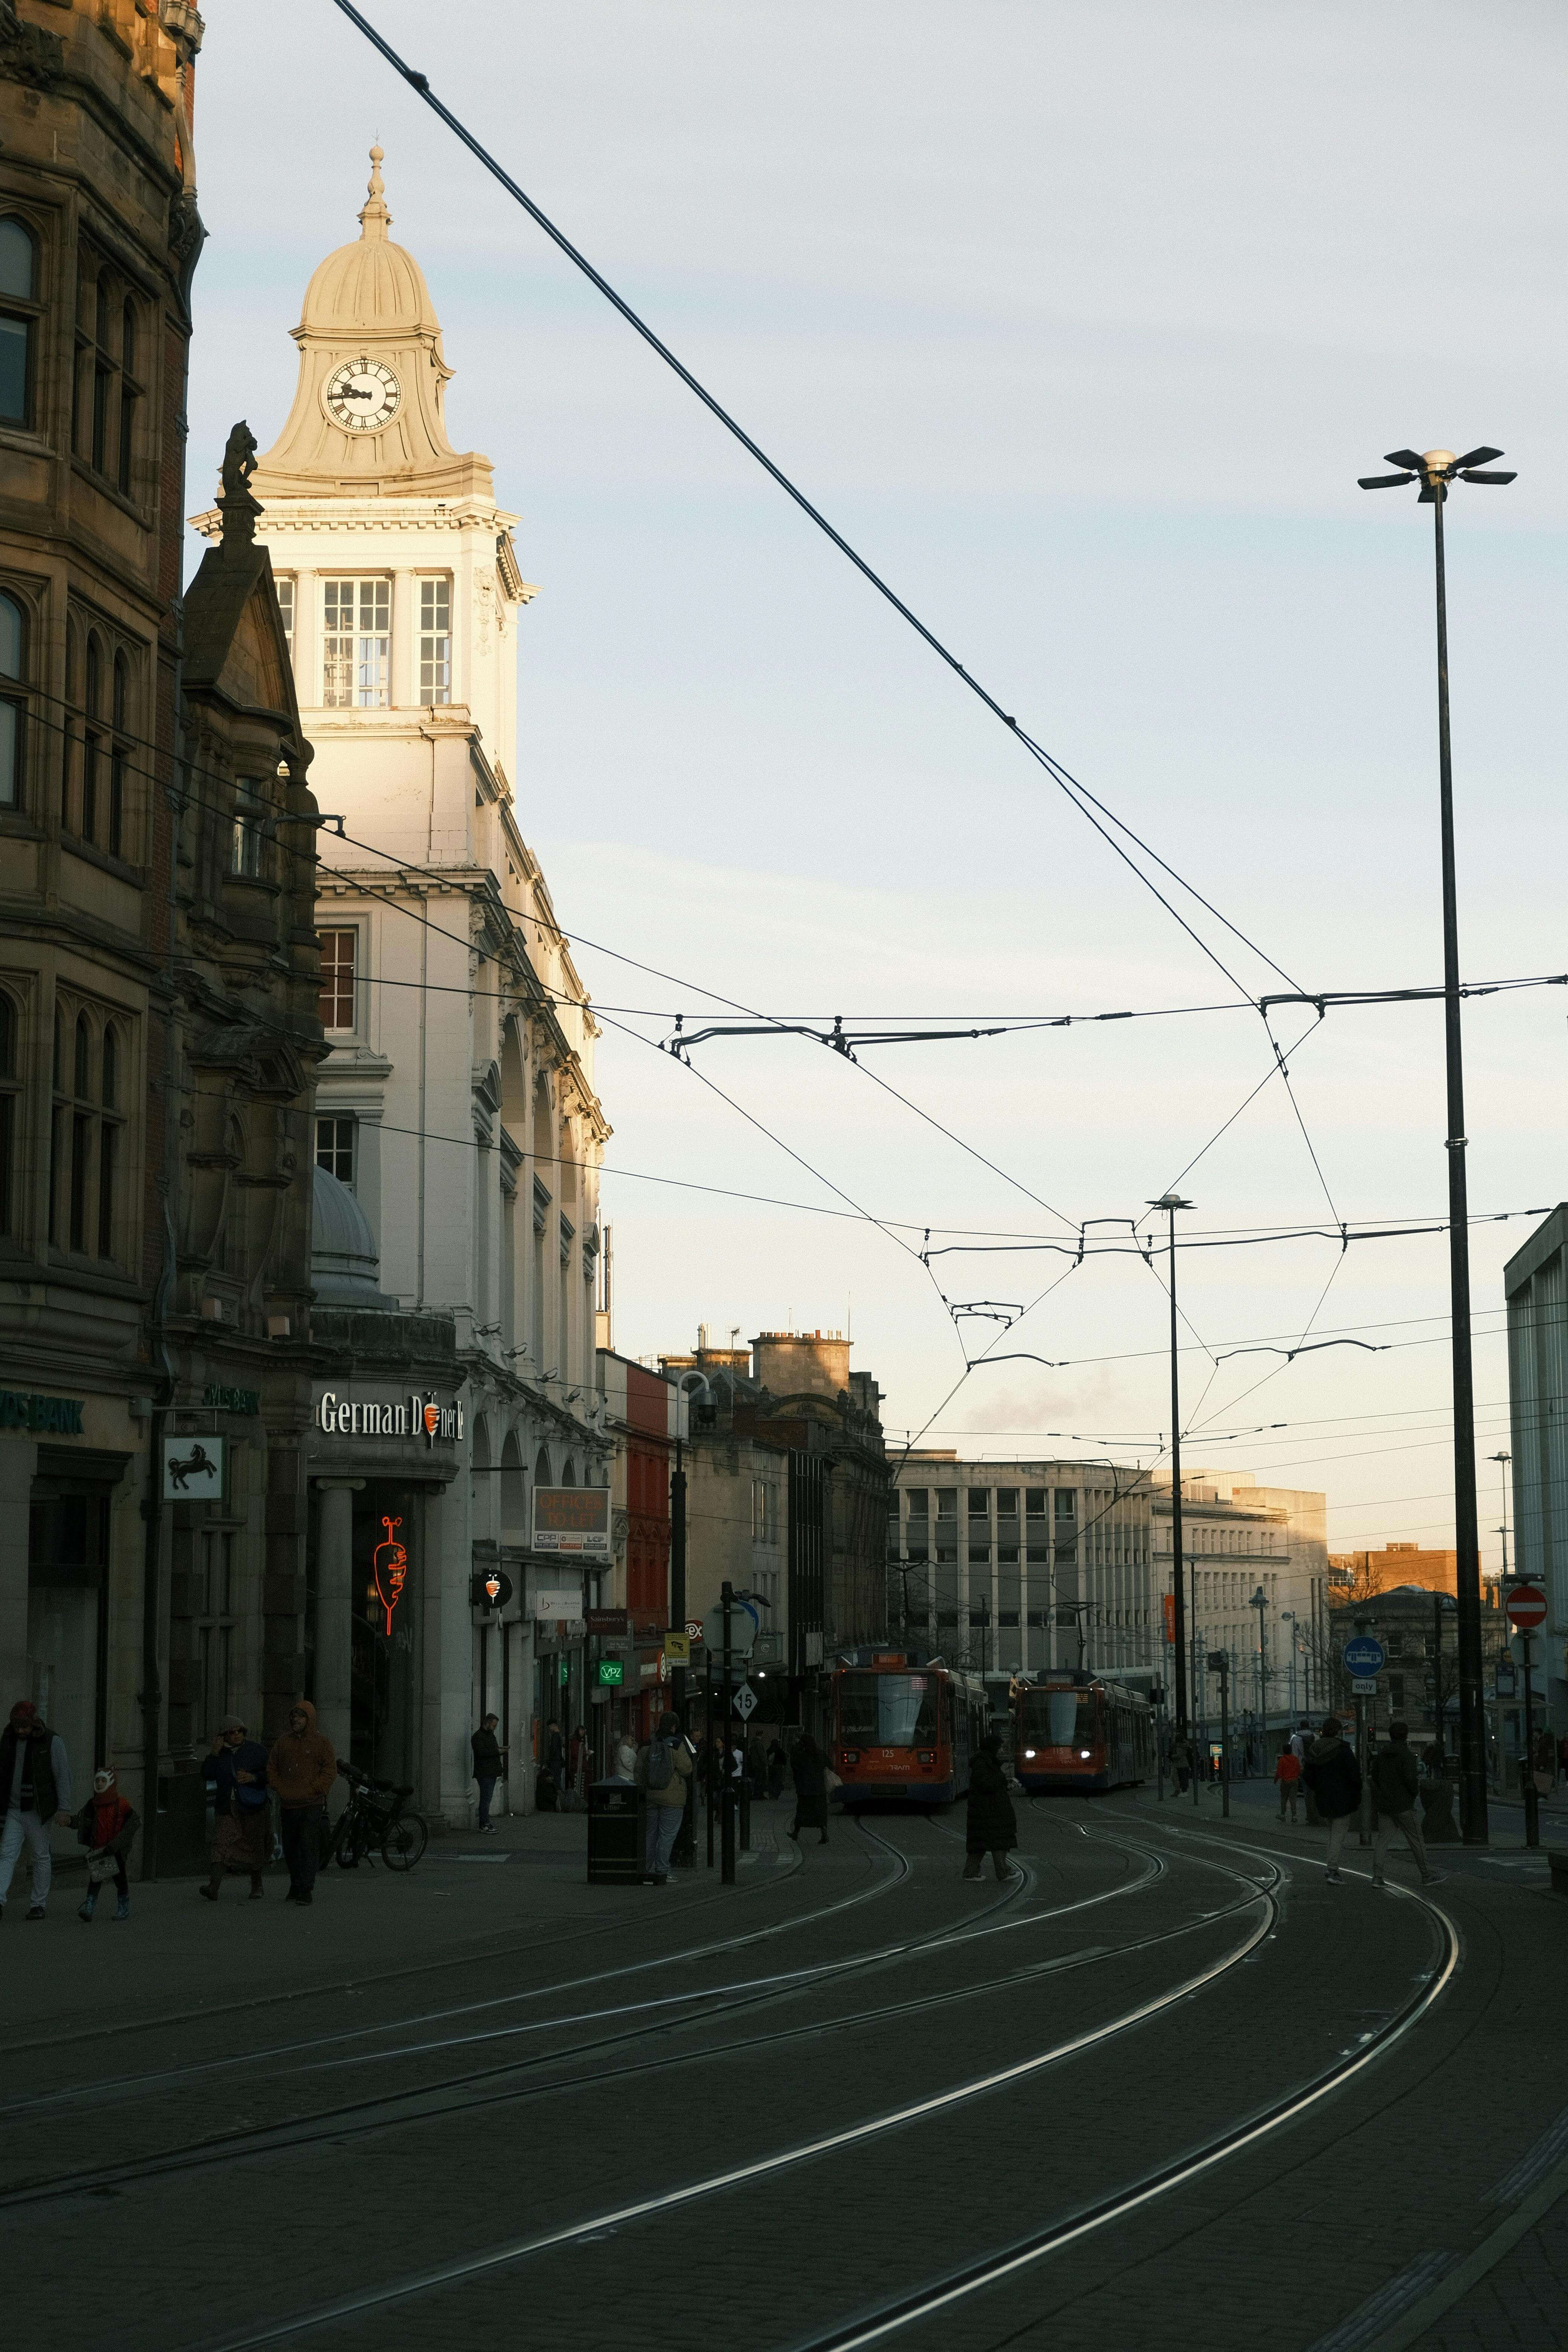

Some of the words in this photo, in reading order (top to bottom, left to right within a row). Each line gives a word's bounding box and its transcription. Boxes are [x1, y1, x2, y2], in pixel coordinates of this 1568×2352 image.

[30, 1394, 84, 1434] BANK
[321, 1392, 406, 1435] German
[539, 1494, 603, 1510] OFFICES
[546, 1512, 567, 1527] TO
[570, 1513, 597, 1528] LET
[602, 1666, 621, 1678] VPZ
[1355, 1683, 1373, 1692] only
[738, 1694, 752, 1709] 15
